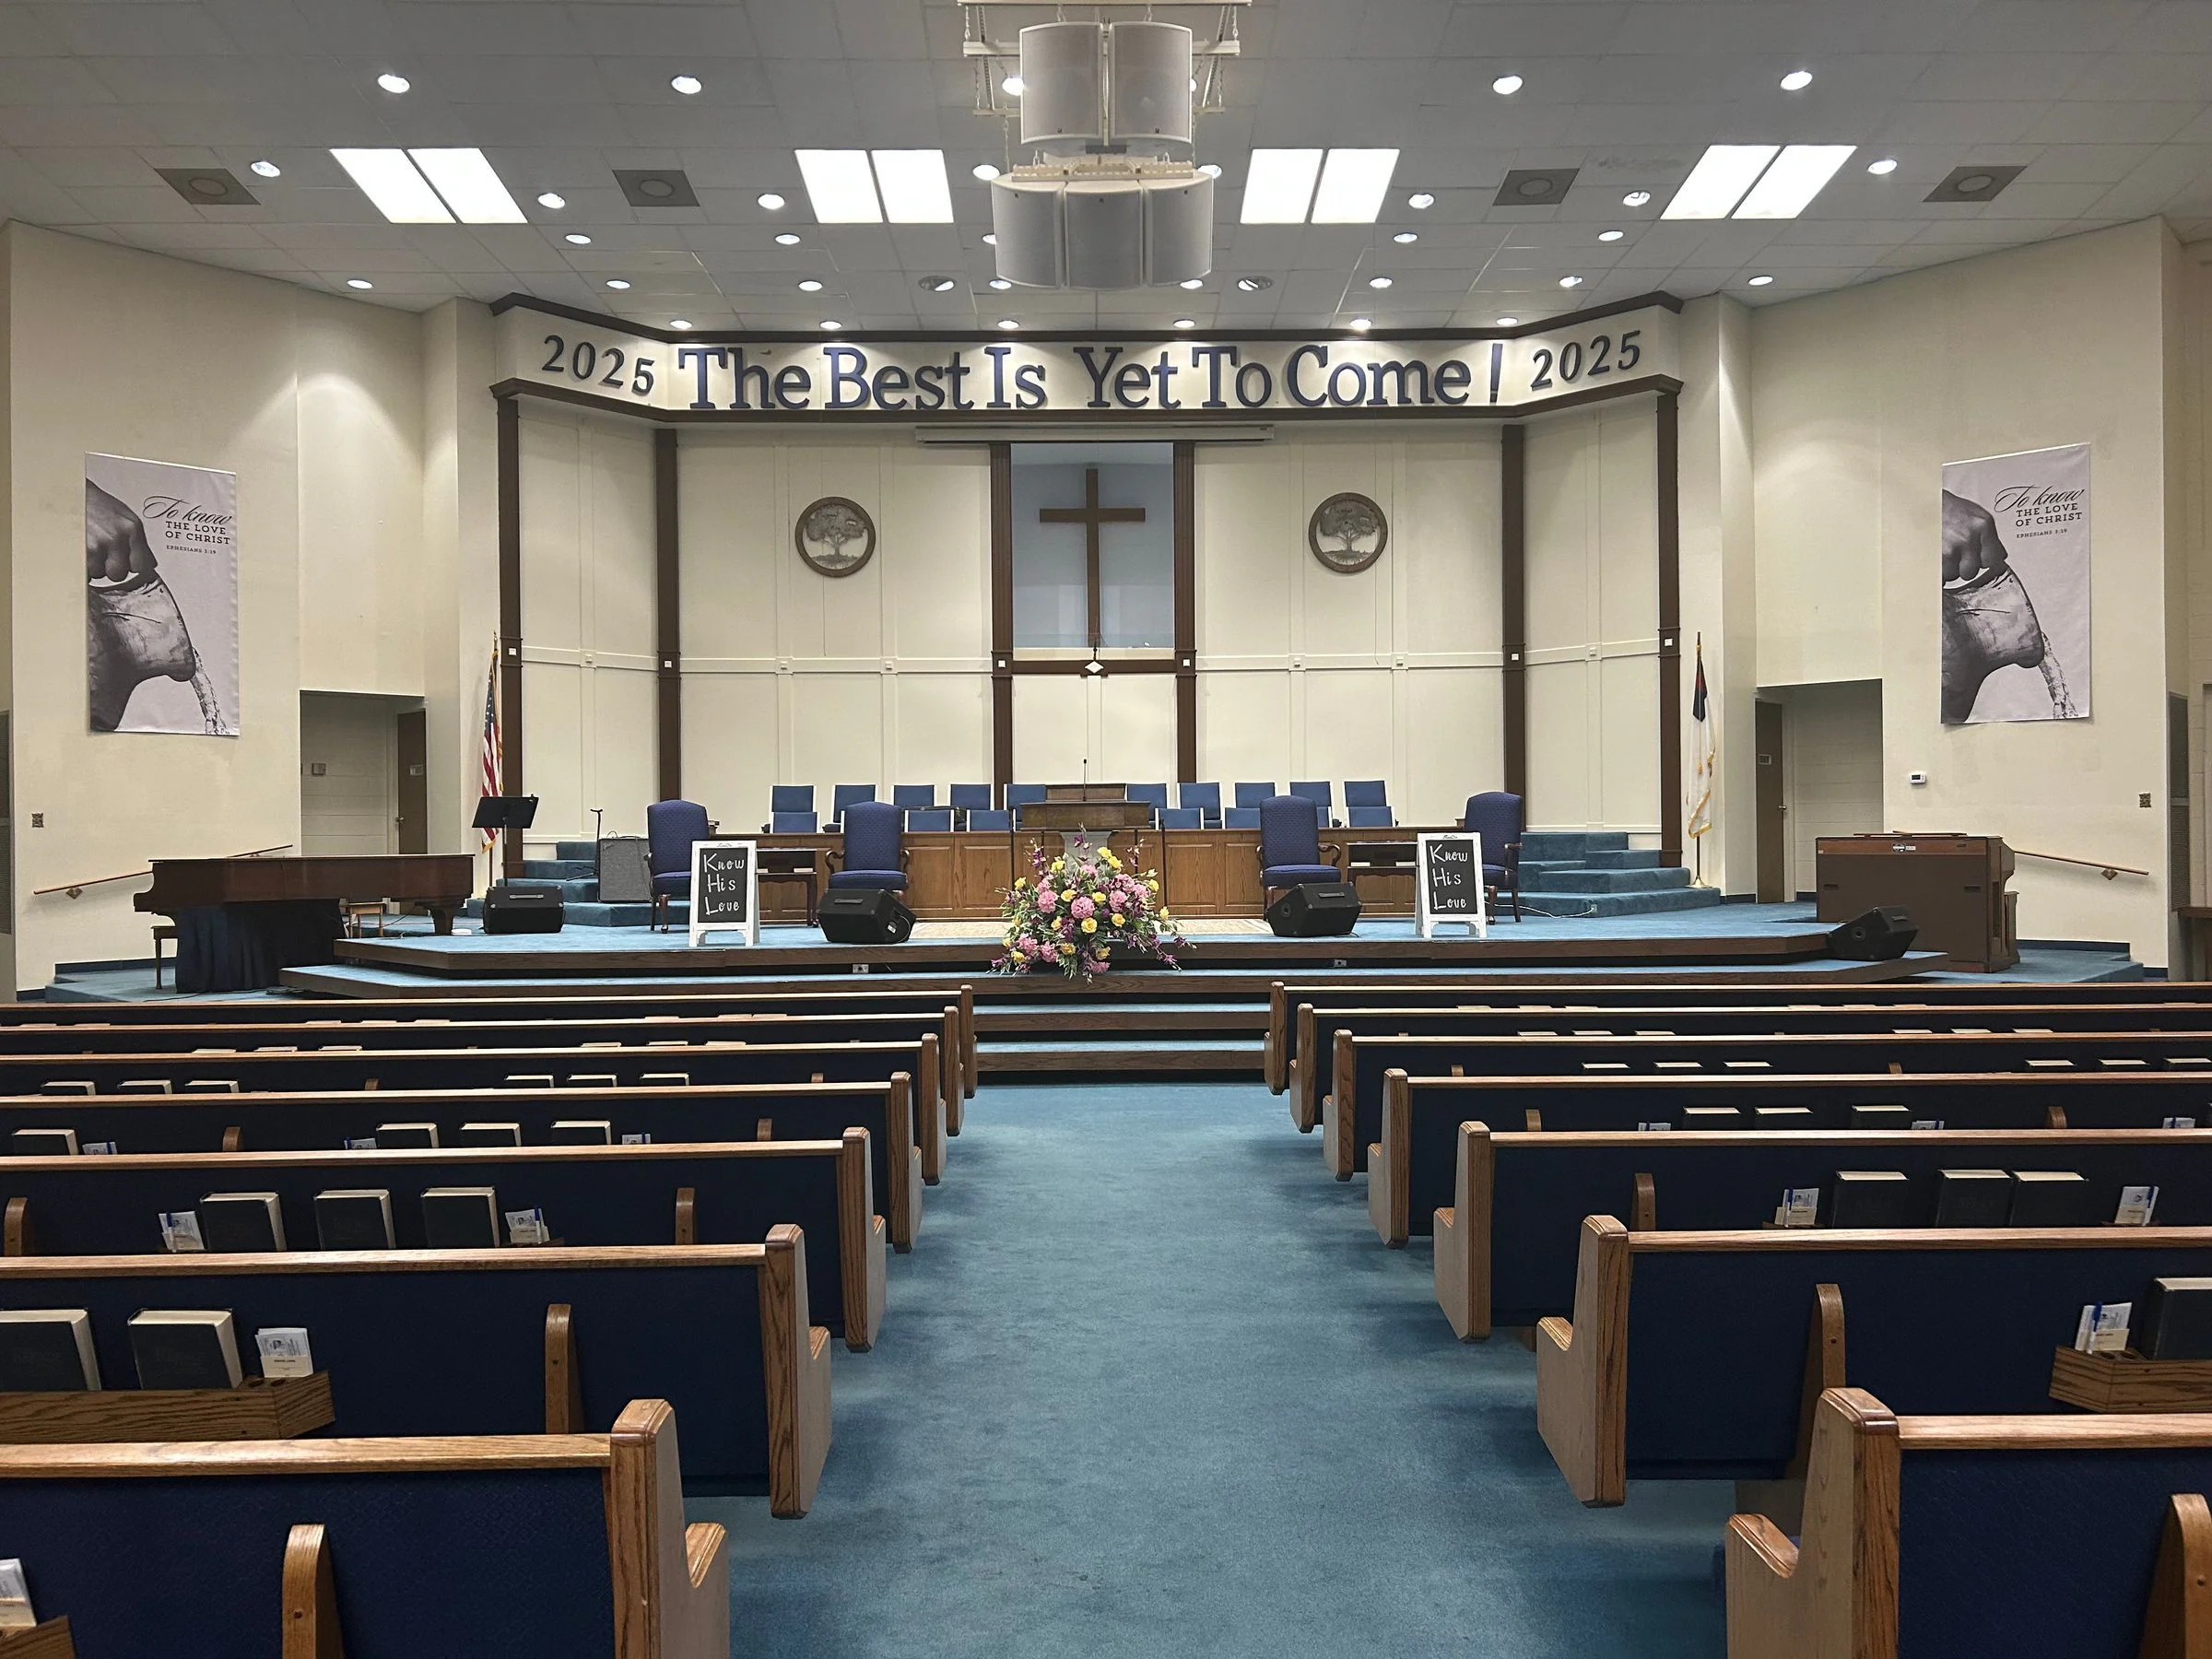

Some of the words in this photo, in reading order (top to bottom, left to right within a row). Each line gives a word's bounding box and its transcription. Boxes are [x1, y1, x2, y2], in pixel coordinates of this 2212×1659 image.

[542, 334, 655, 395] 2025
[1530, 330, 1641, 390] 2025
[677, 347, 811, 410] The
[823, 347, 974, 411] Best
[983, 346, 1047, 410] Is
[1073, 346, 1182, 410] Yet
[1191, 345, 1273, 408] To
[1994, 484, 2041, 513] To
[2032, 486, 2085, 506] know
[143, 495, 190, 519] To
[182, 504, 232, 525] know
[2015, 518, 2031, 527] OF
[2036, 512, 2083, 524] CHRIST
[2016, 507, 2040, 518] THE
[2045, 502, 2078, 514] LOVE
[165, 530, 182, 539] OF
[186, 533, 230, 545] CHRIST
[166, 521, 190, 531] THE
[194, 524, 226, 535] LOVE
[2016, 530, 2053, 539] EPHESIANS
[166, 545, 203, 553] EPHESIANS
[703, 853, 745, 873] Know
[1430, 843, 1468, 865] Know
[707, 873, 736, 893] His
[1432, 867, 1462, 888] His
[705, 896, 740, 916] Love
[1433, 890, 1467, 911] Love
